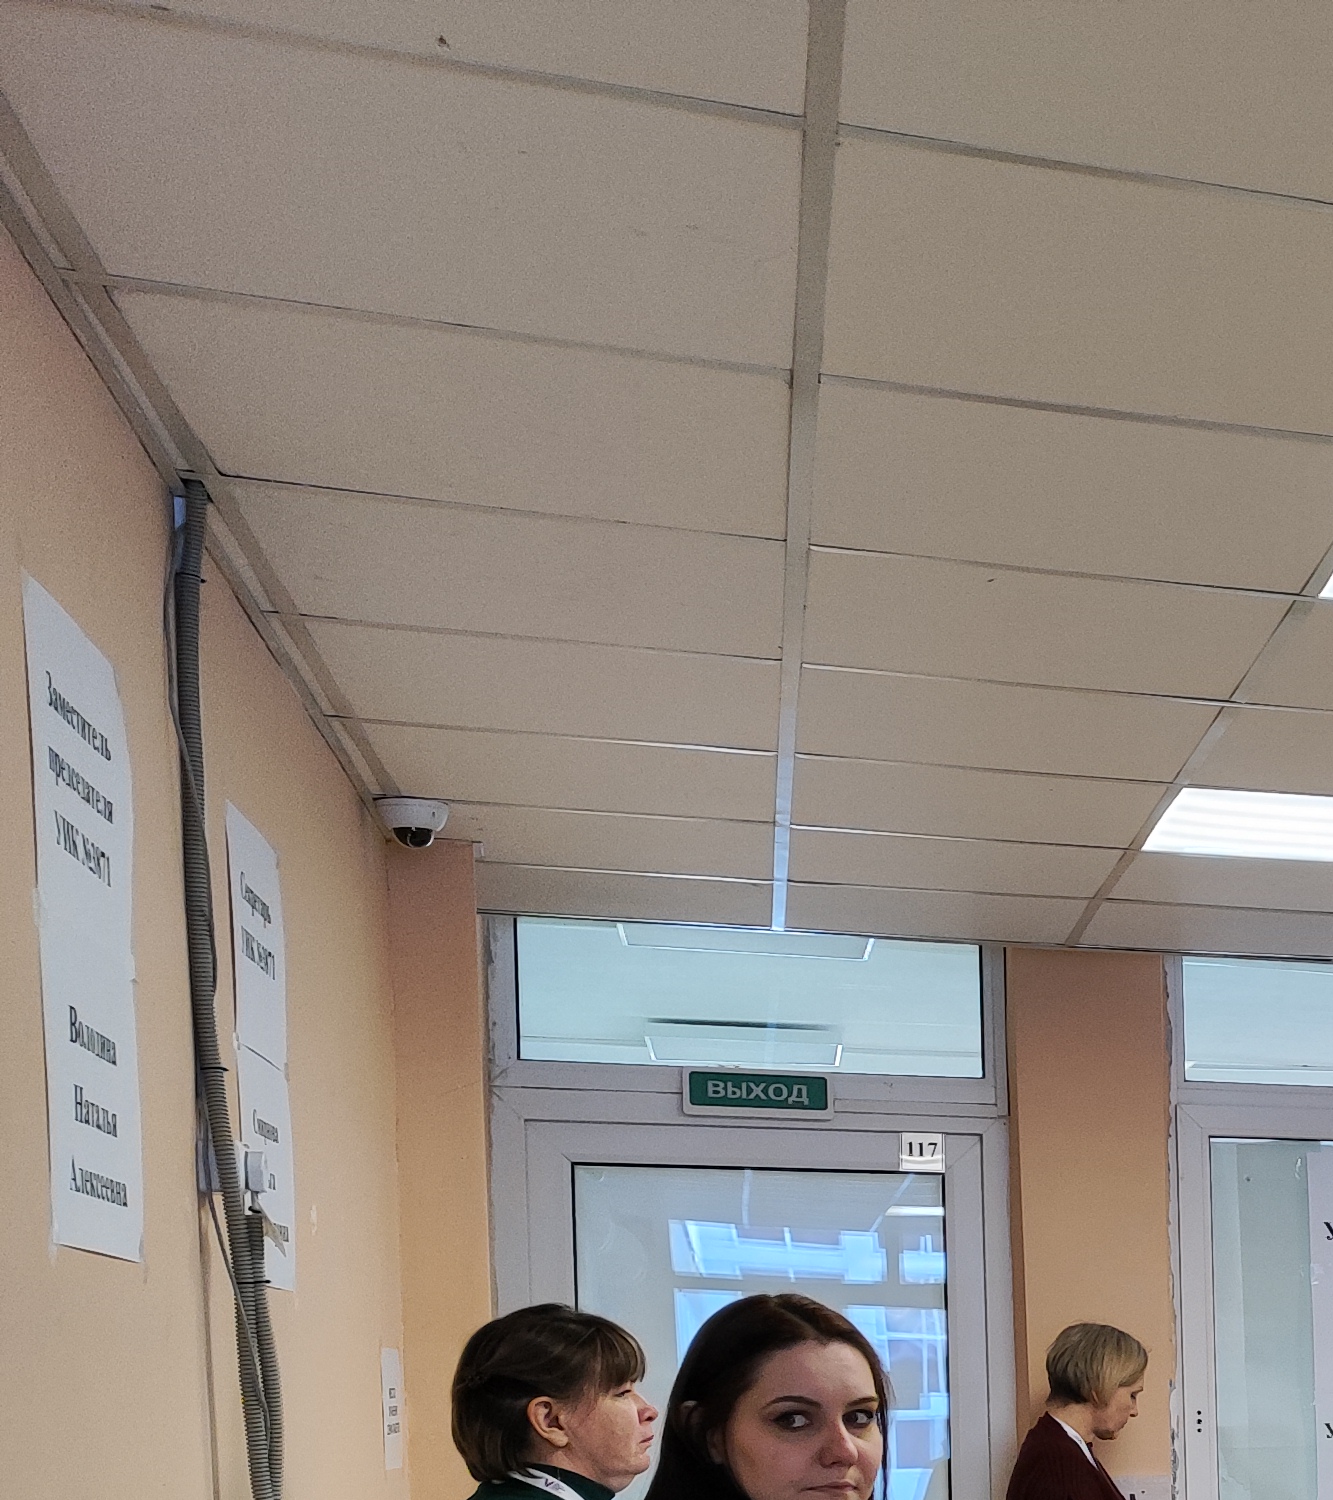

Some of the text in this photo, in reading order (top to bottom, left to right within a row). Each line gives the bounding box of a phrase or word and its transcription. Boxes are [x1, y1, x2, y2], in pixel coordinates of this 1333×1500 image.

[45, 670, 112, 761] Заместитель
[48, 745, 114, 824] председателя
[54, 809, 80, 861] УИК
[68, 1004, 117, 1067] Володина
[73, 1083, 118, 1138] Наталья
[706, 1080, 810, 1105] ВЫХОД
[906, 1141, 938, 1158] 117
[69, 1155, 128, 1208] Алексеевна
